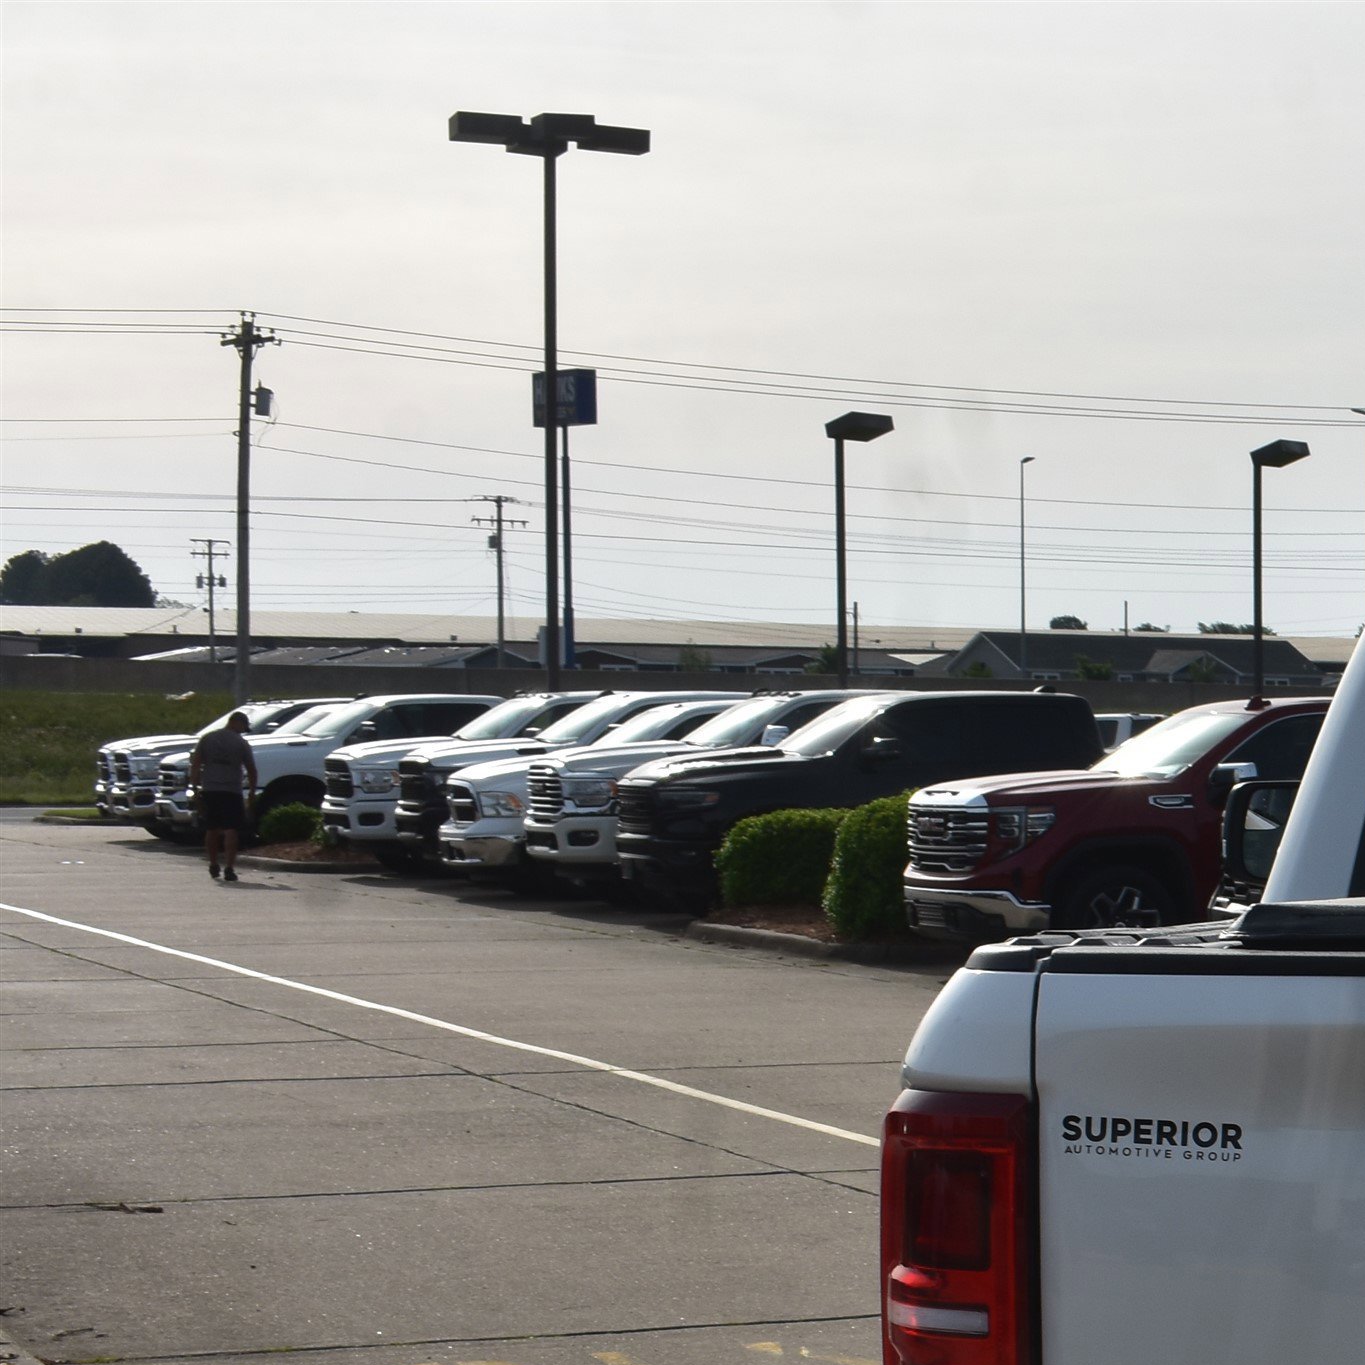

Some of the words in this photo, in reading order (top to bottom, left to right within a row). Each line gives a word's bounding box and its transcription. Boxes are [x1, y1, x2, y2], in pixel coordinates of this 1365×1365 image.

[1062, 1115, 1243, 1149] SUPERIOR
[1064, 1144, 1173, 1159] AUTOMOTIVE
[1183, 1150, 1241, 1162] GROUP
